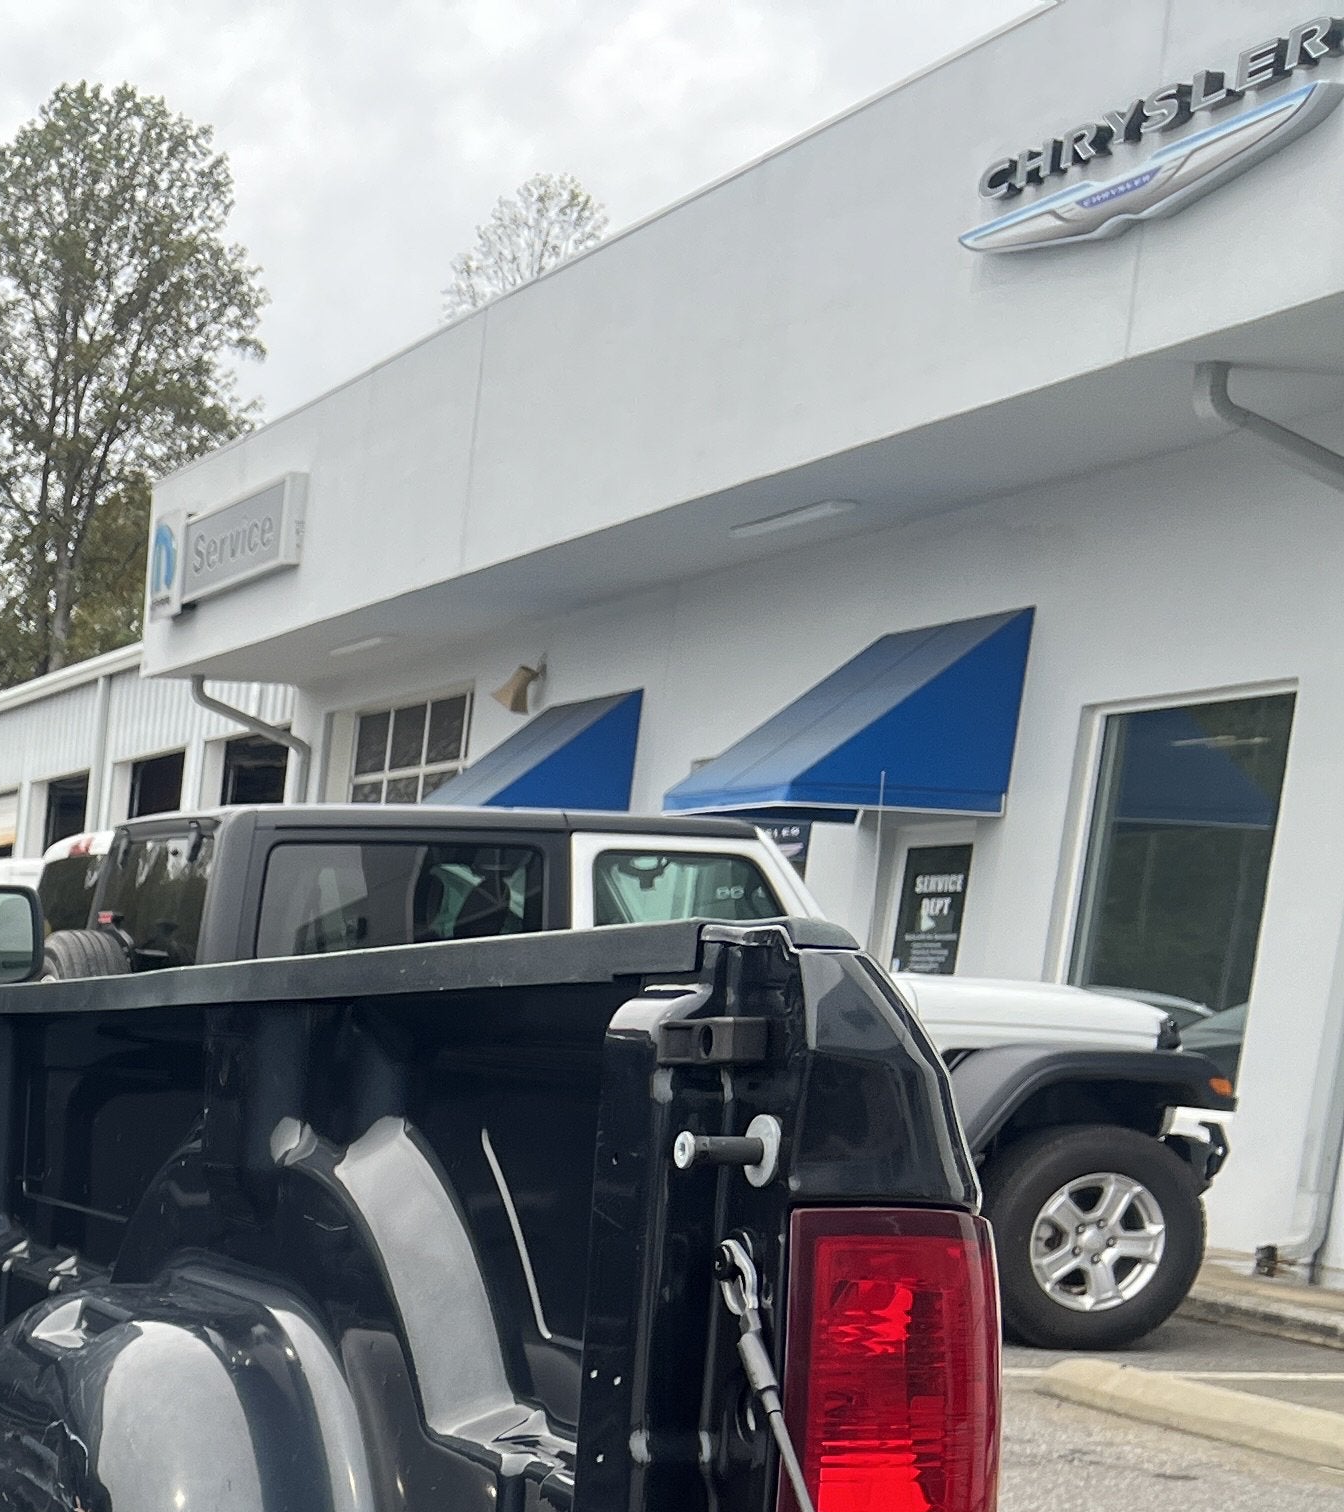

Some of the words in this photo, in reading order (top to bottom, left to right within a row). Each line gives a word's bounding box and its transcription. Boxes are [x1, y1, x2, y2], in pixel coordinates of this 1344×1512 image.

[978, 16, 1332, 201] CHRYSLER
[192, 515, 274, 575] Service
[914, 873, 965, 894] SERVICE
